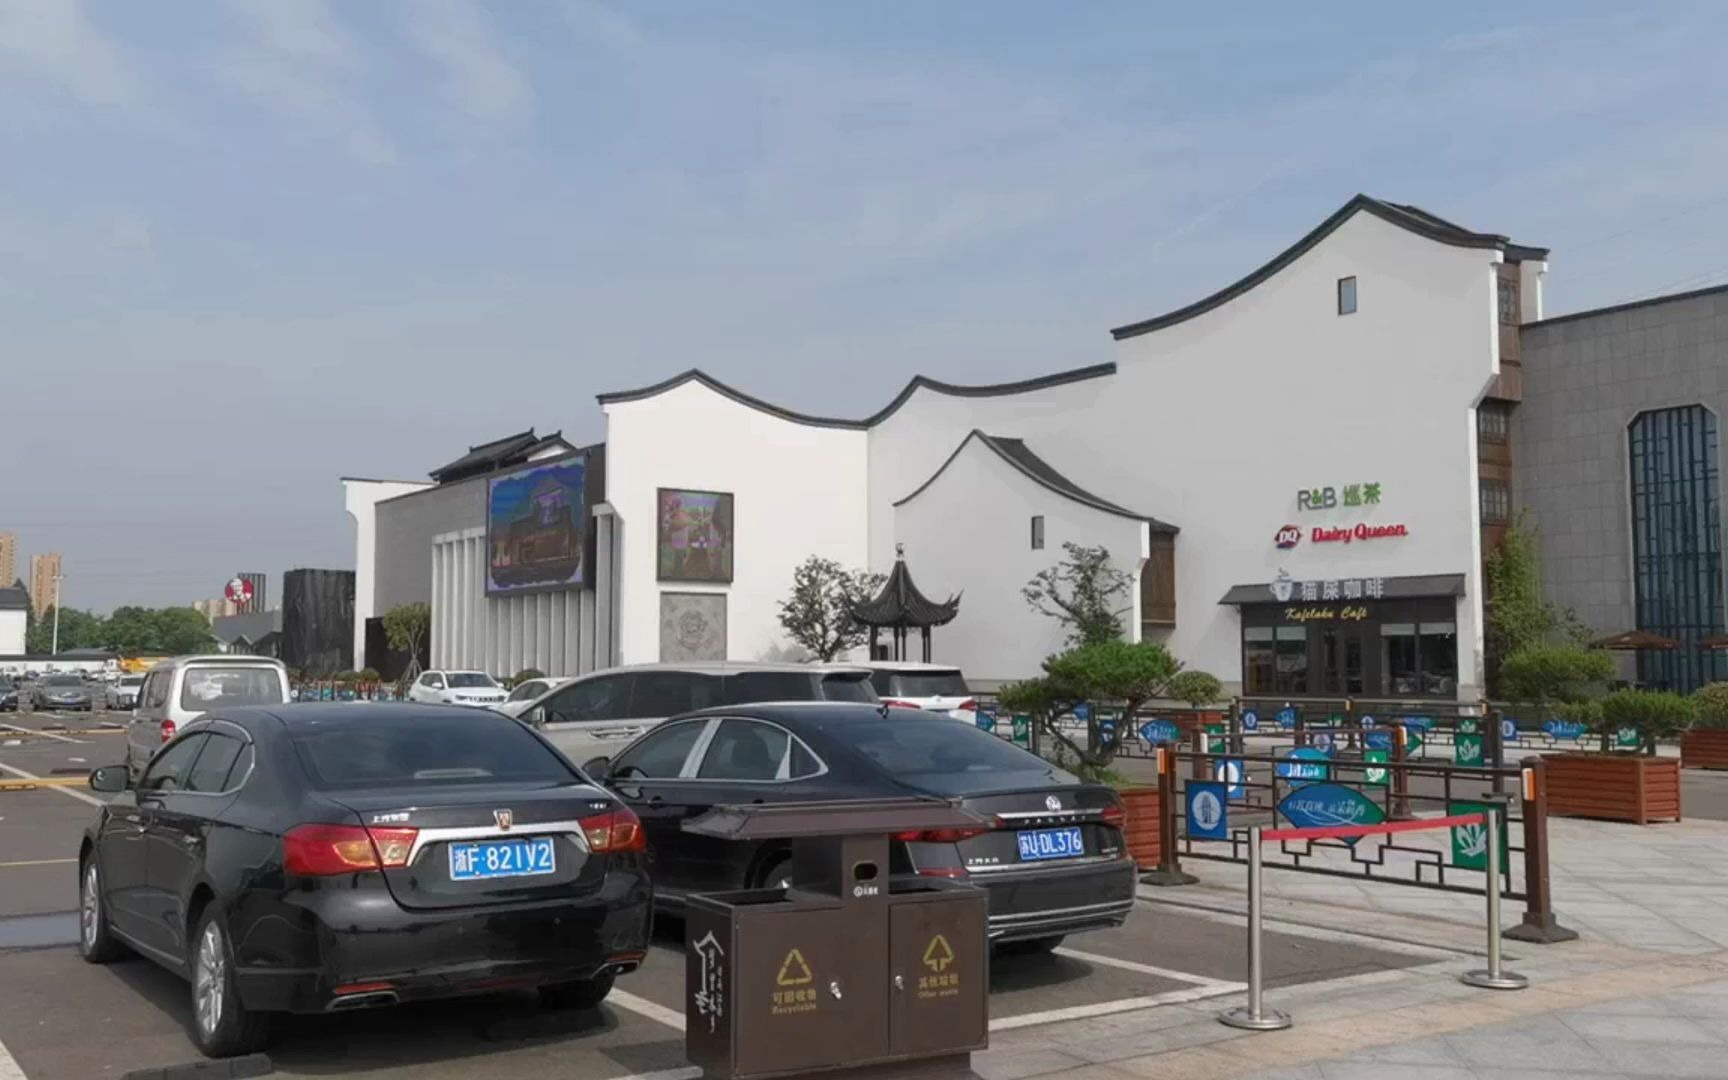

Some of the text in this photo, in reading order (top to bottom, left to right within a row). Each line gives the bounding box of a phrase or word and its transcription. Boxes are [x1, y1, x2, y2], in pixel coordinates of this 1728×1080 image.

[1297, 487, 1337, 511] R&B
[1343, 482, 1381, 506] 巡茶
[1312, 523, 1406, 544] Dairy Queen
[1301, 577, 1384, 601] 猫屎咖啡
